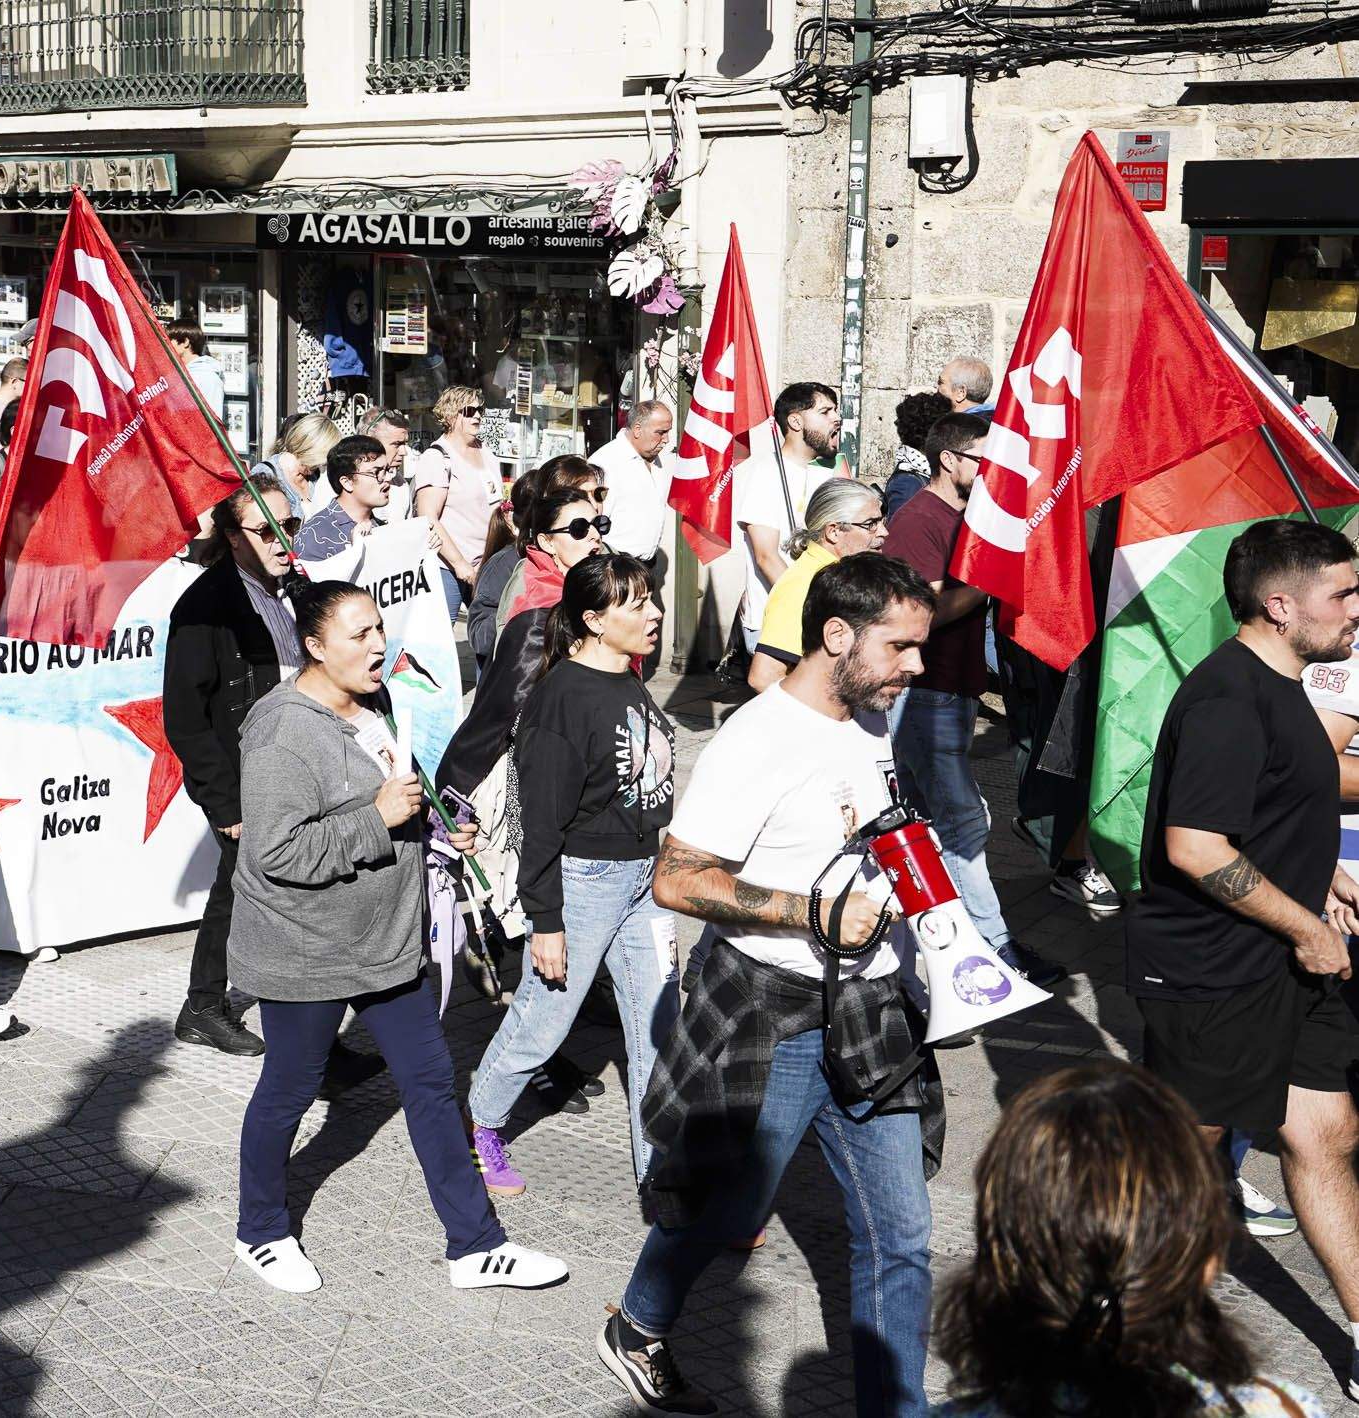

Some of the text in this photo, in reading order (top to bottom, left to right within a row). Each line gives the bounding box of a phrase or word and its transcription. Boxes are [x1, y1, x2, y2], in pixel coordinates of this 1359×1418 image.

[1121, 165, 1163, 176] Alarma
[34, 214, 166, 239] PEOSA
[298, 214, 471, 246] AGASALLO
[488, 233, 605, 249] regalo souvenirs
[1025, 497, 1055, 537] ración
[47, 634, 85, 669] AO
[93, 625, 155, 664] MAR
[1310, 664, 1351, 694] 93
[40, 774, 111, 806] Galiza
[642, 772, 674, 810] ORCE
[41, 810, 101, 841] Nova
